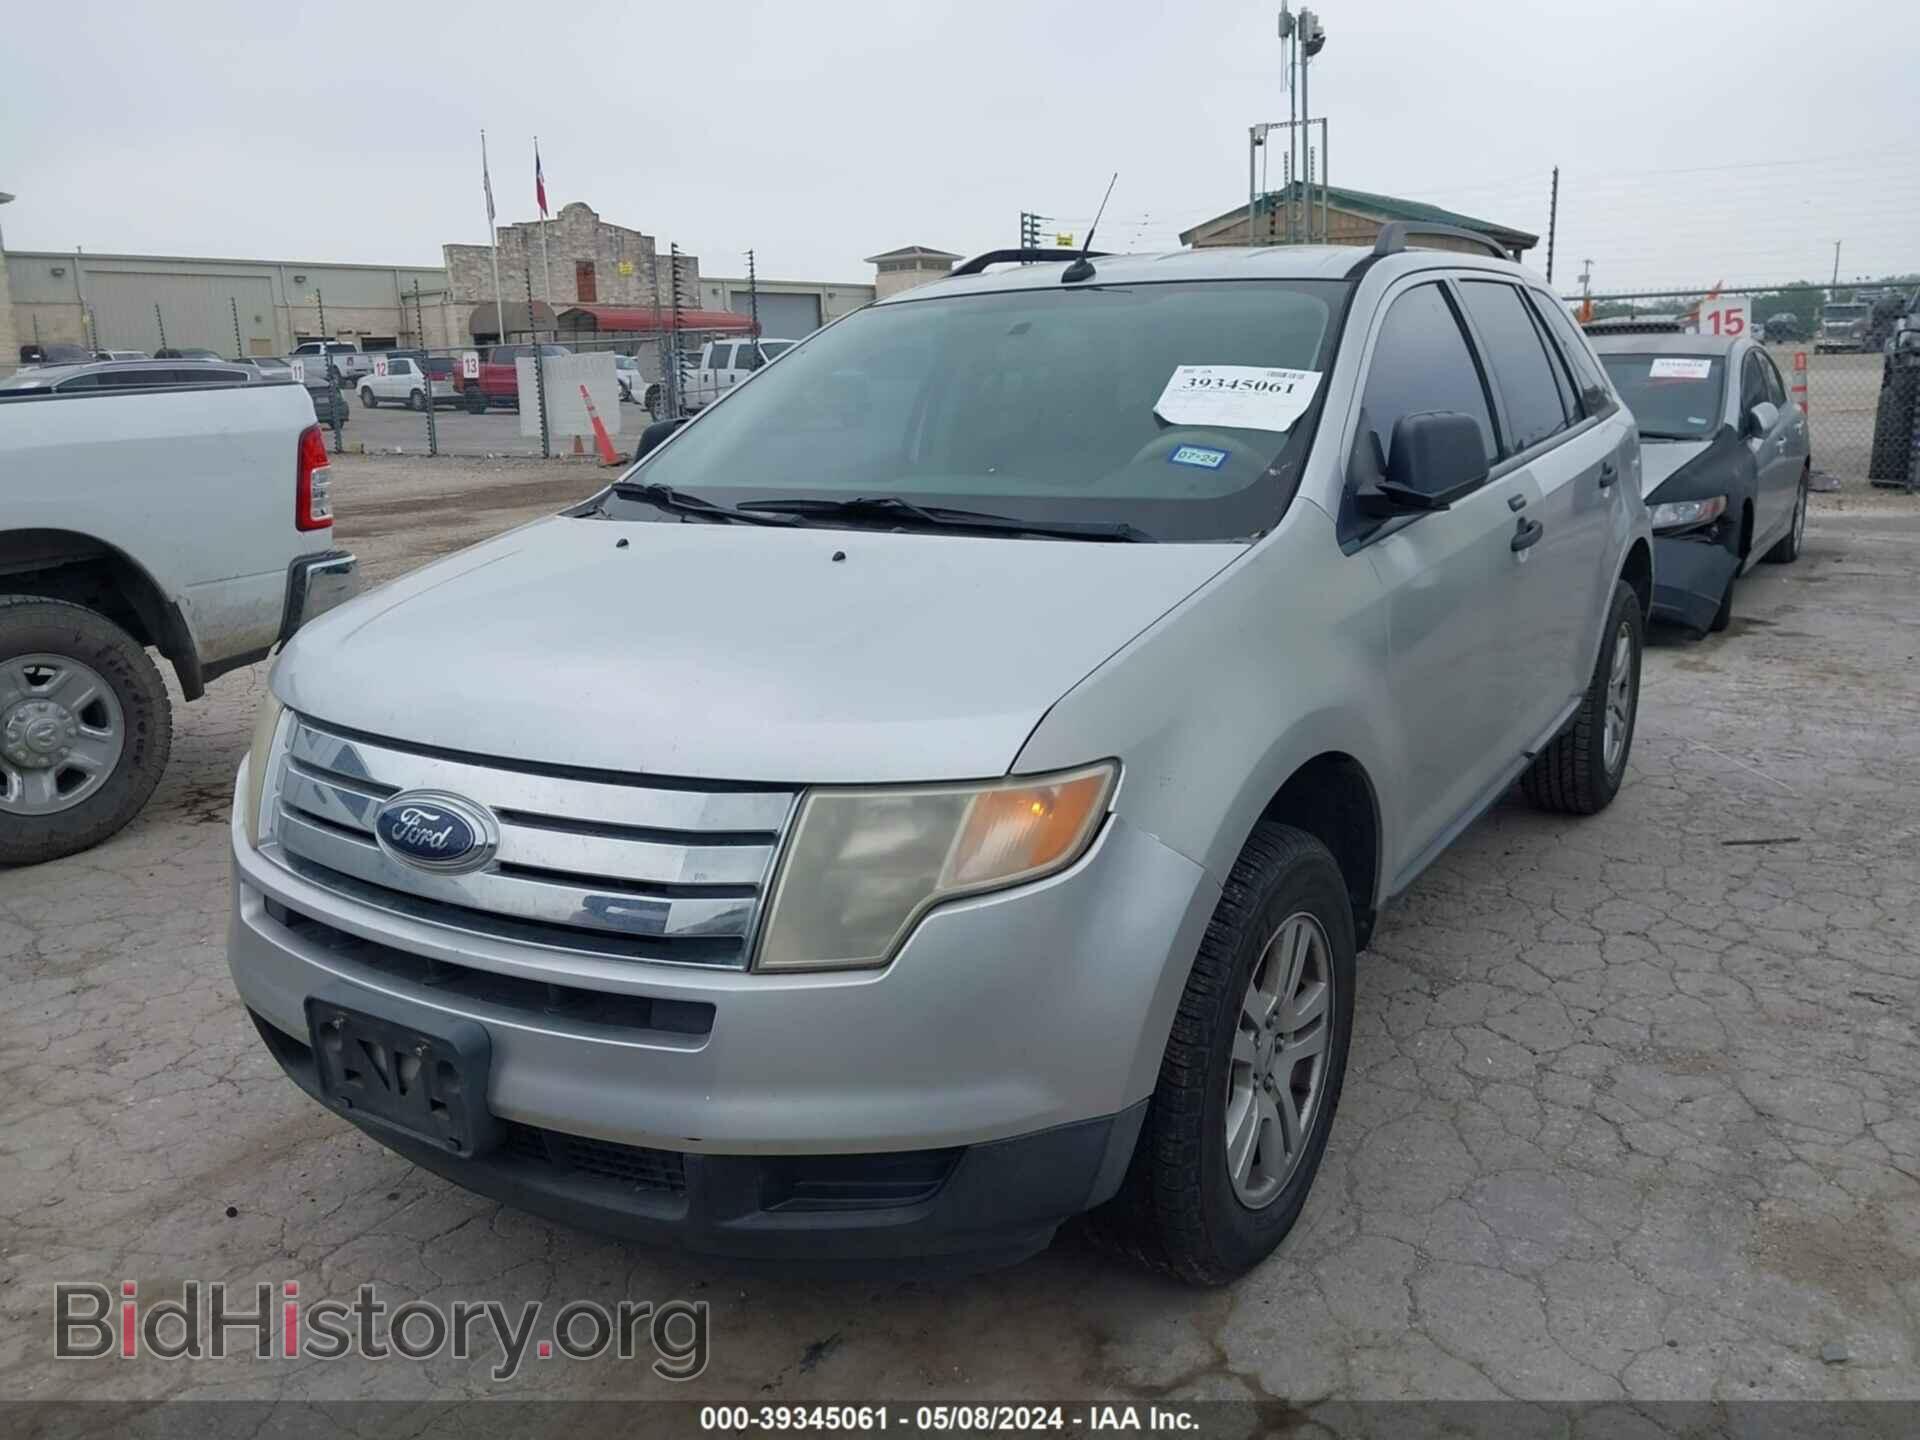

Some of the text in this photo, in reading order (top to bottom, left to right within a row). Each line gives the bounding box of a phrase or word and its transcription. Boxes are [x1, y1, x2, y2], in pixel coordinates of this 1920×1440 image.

[1707, 308, 1745, 336] 15
[375, 361, 387, 377] 12
[465, 357, 478, 374] 13
[1182, 377, 1296, 394] 39345061
[1178, 451, 1218, 463] 07-24
[391, 807, 453, 849] Ford
